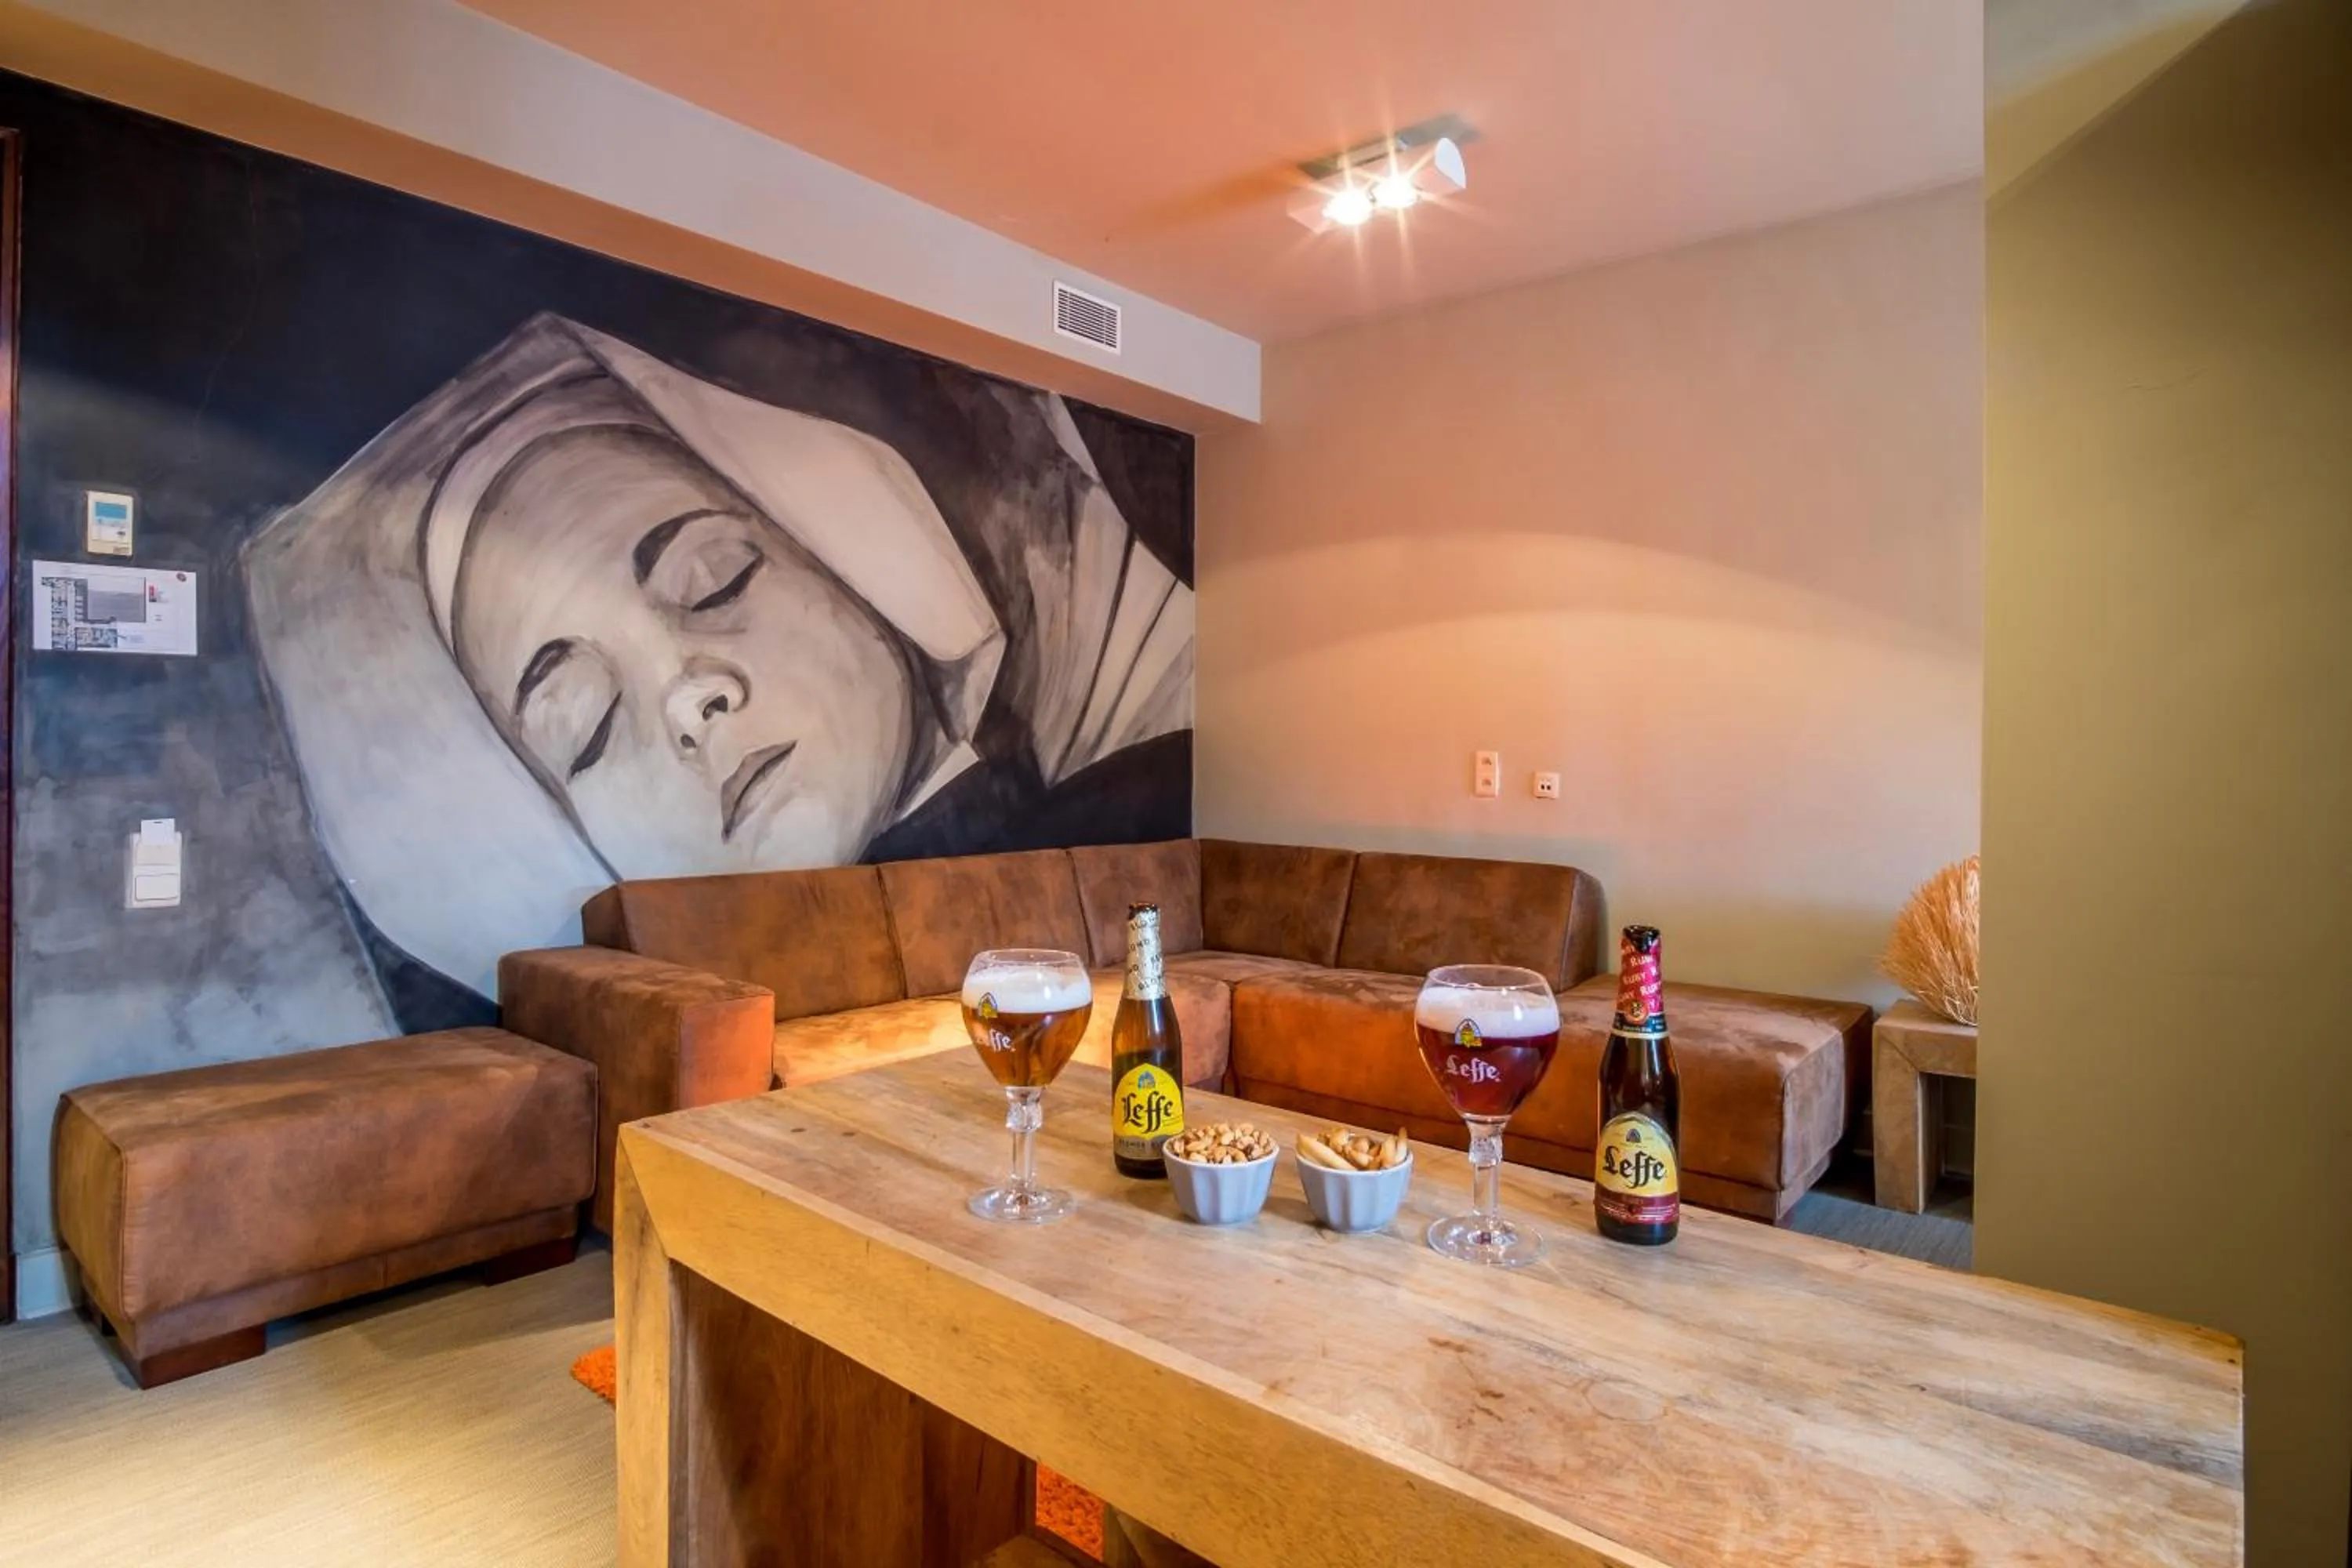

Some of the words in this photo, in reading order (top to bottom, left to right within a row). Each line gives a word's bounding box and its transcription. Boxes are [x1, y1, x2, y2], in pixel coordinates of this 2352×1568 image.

[1445, 1054, 1499, 1083] Leffe
[1121, 1091, 1173, 1134] Leffe
[1602, 1145, 1664, 1189] Leffe
